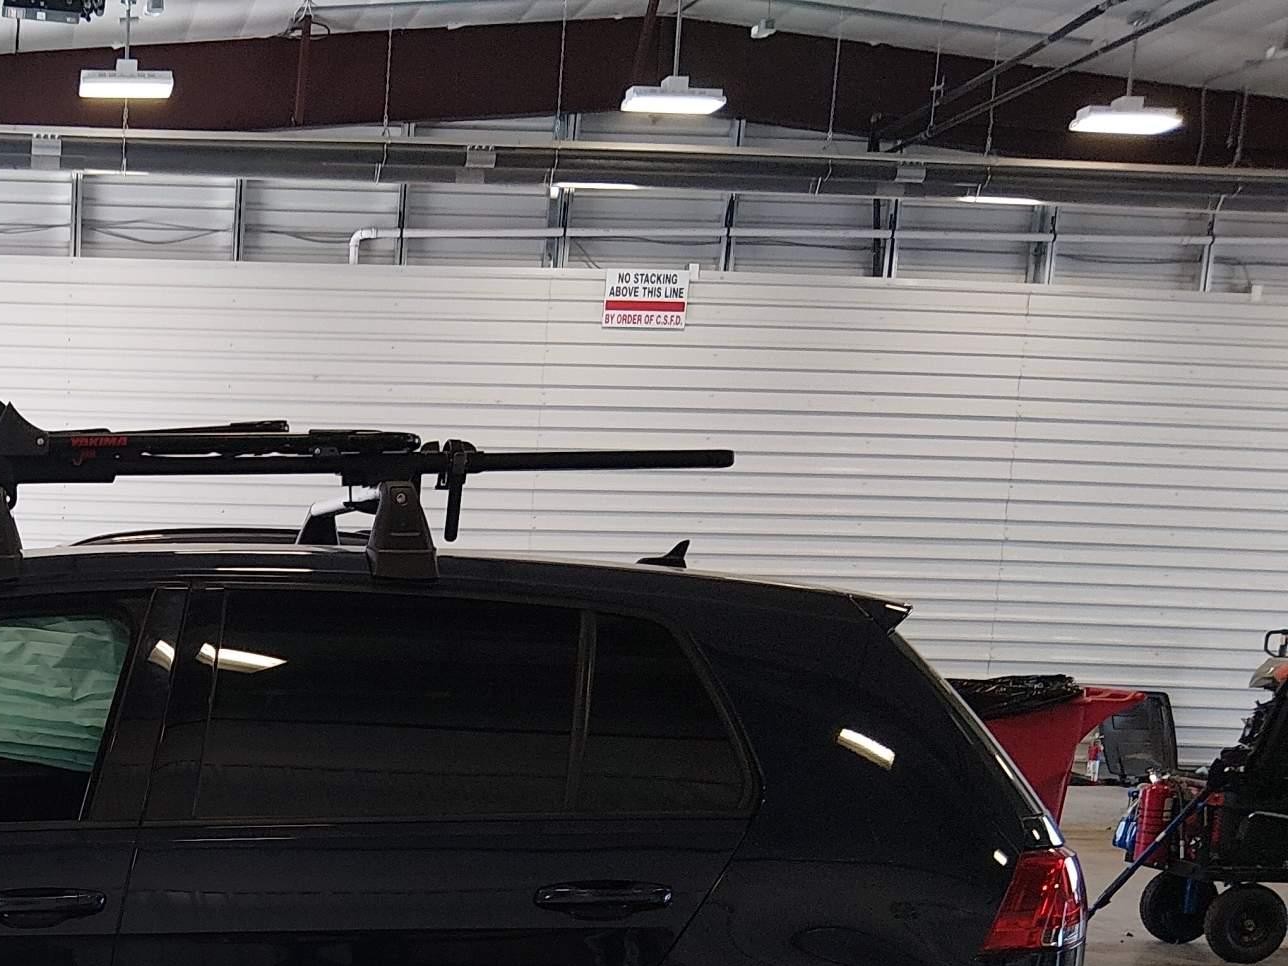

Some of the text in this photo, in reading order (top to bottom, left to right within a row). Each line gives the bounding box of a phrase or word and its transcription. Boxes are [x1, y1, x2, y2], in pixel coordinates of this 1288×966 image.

[618, 272, 678, 285] NO STACKING
[609, 286, 684, 299] ABOVE THIS LINE
[604, 313, 683, 326] BY ORDER OF C.S.F.D.
[71, 436, 128, 447] YAKIMA
